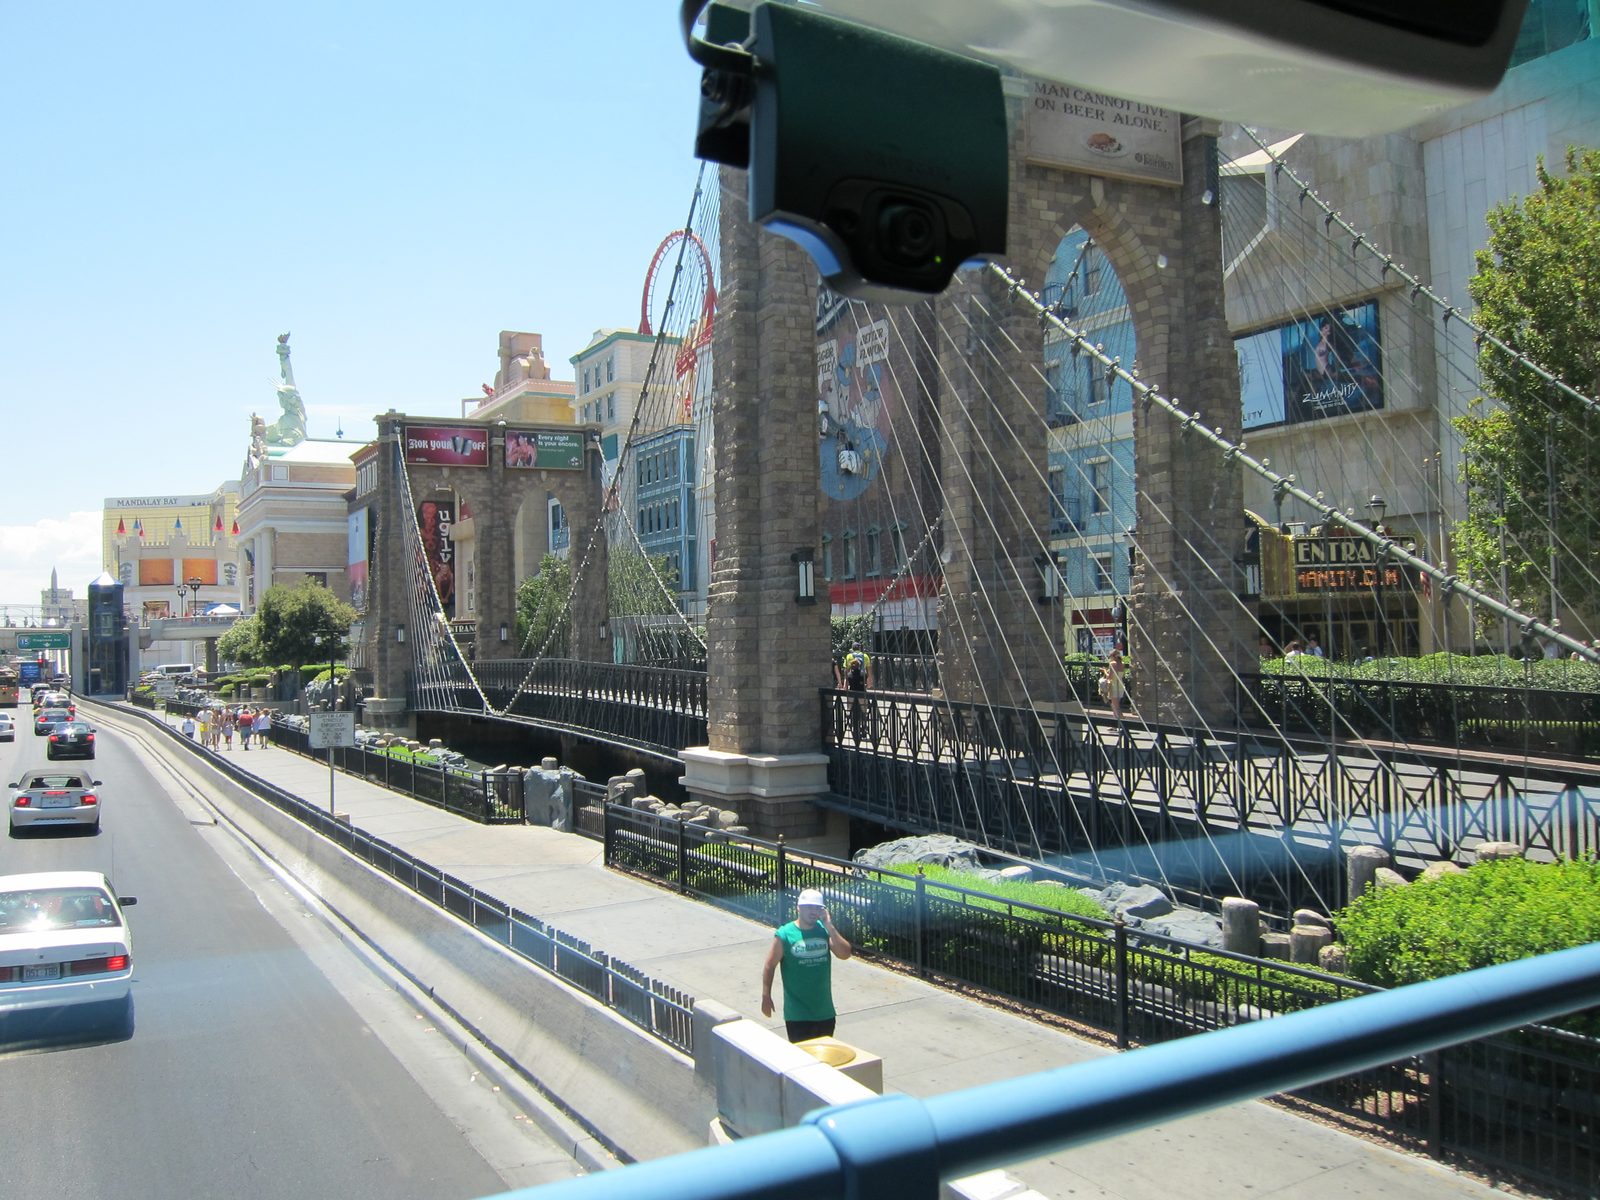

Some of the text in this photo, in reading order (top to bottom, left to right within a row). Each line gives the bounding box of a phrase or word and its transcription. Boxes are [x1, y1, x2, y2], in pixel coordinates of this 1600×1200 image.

[1034, 82, 1168, 118] MAN CANNOT LIVE
[1034, 97, 1168, 133] ON BEER ALONE.
[117, 499, 161, 507] MANDALAY
